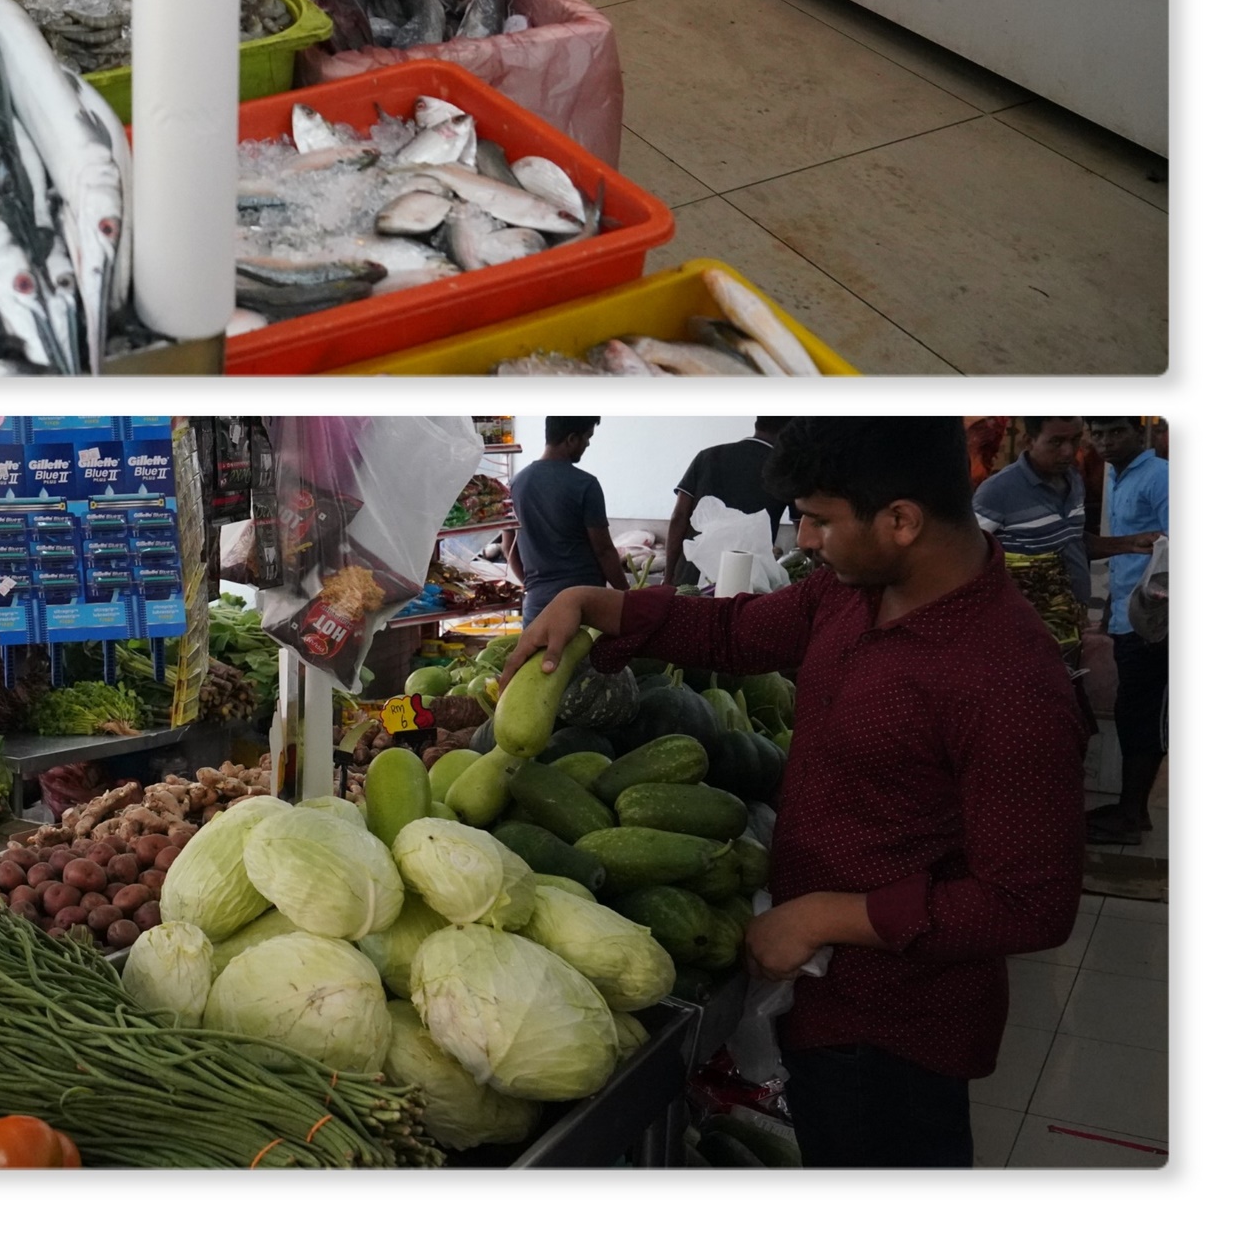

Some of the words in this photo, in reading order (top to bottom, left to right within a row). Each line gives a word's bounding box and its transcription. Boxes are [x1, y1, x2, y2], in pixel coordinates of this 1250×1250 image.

[28, 458, 69, 470] Gillette
[78, 457, 119, 468] Gillette
[128, 455, 168, 466] Gillette
[8, 472, 19, 485] II
[34, 470, 59, 480] Blue
[58, 471, 69, 483] II
[84, 468, 108, 478] Blue
[108, 469, 119, 481] II
[134, 466, 158, 477] Blue
[157, 467, 168, 479] II
[312, 613, 347, 643] HOT
